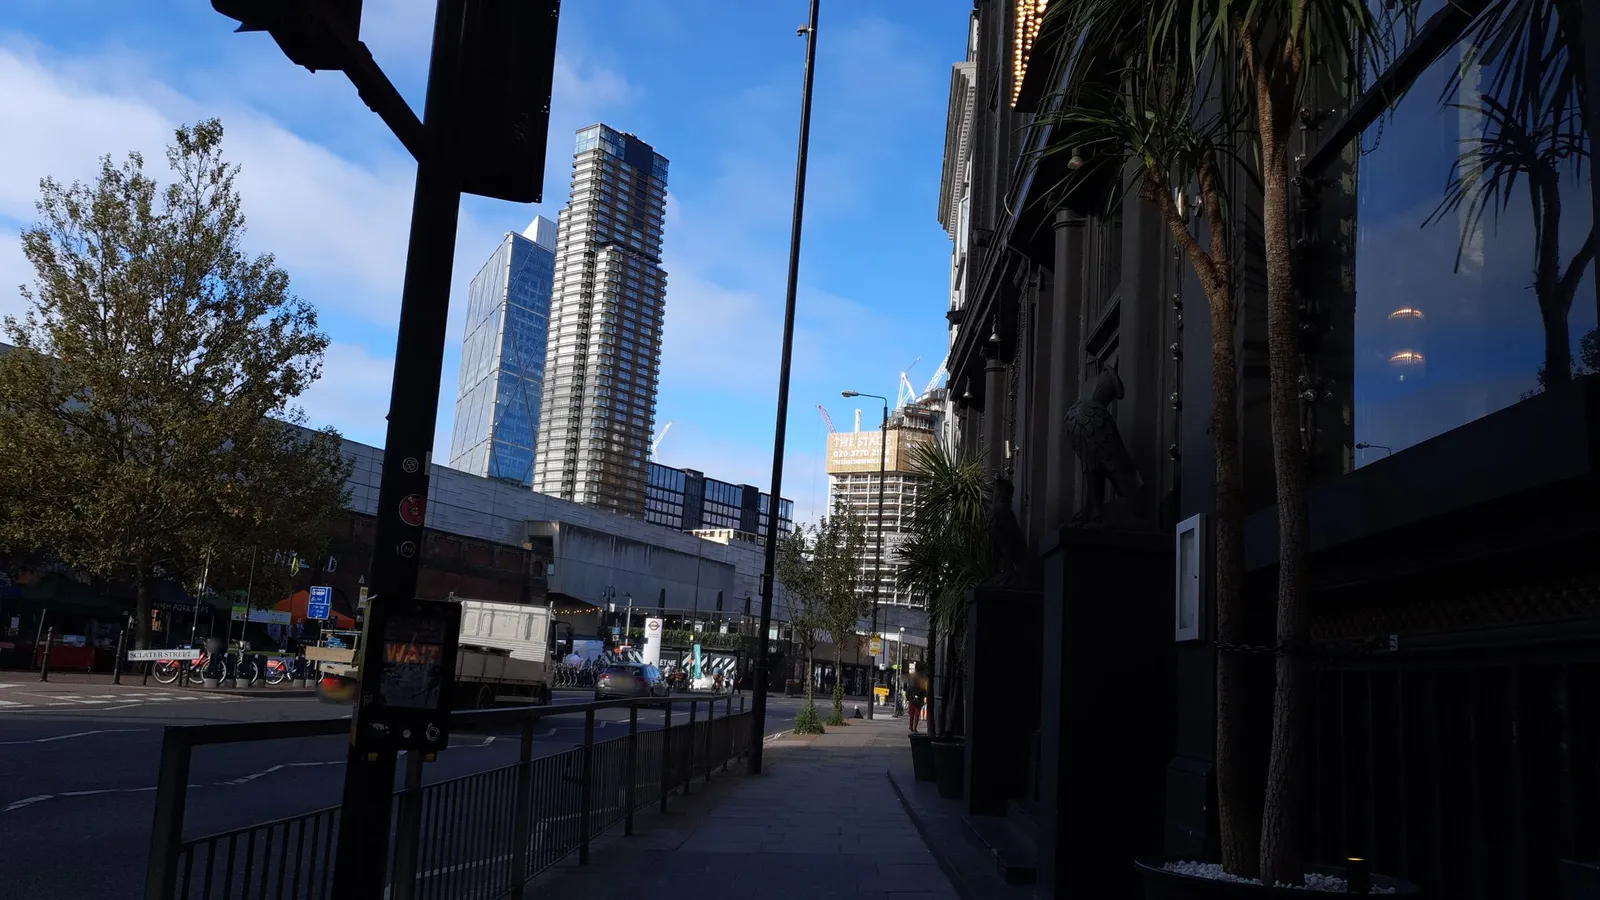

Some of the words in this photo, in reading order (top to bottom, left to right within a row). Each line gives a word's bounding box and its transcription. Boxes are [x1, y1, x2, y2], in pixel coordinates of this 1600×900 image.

[834, 436, 855, 448] THE
[173, 603, 191, 612] PORK
[384, 643, 439, 664] WAIT
